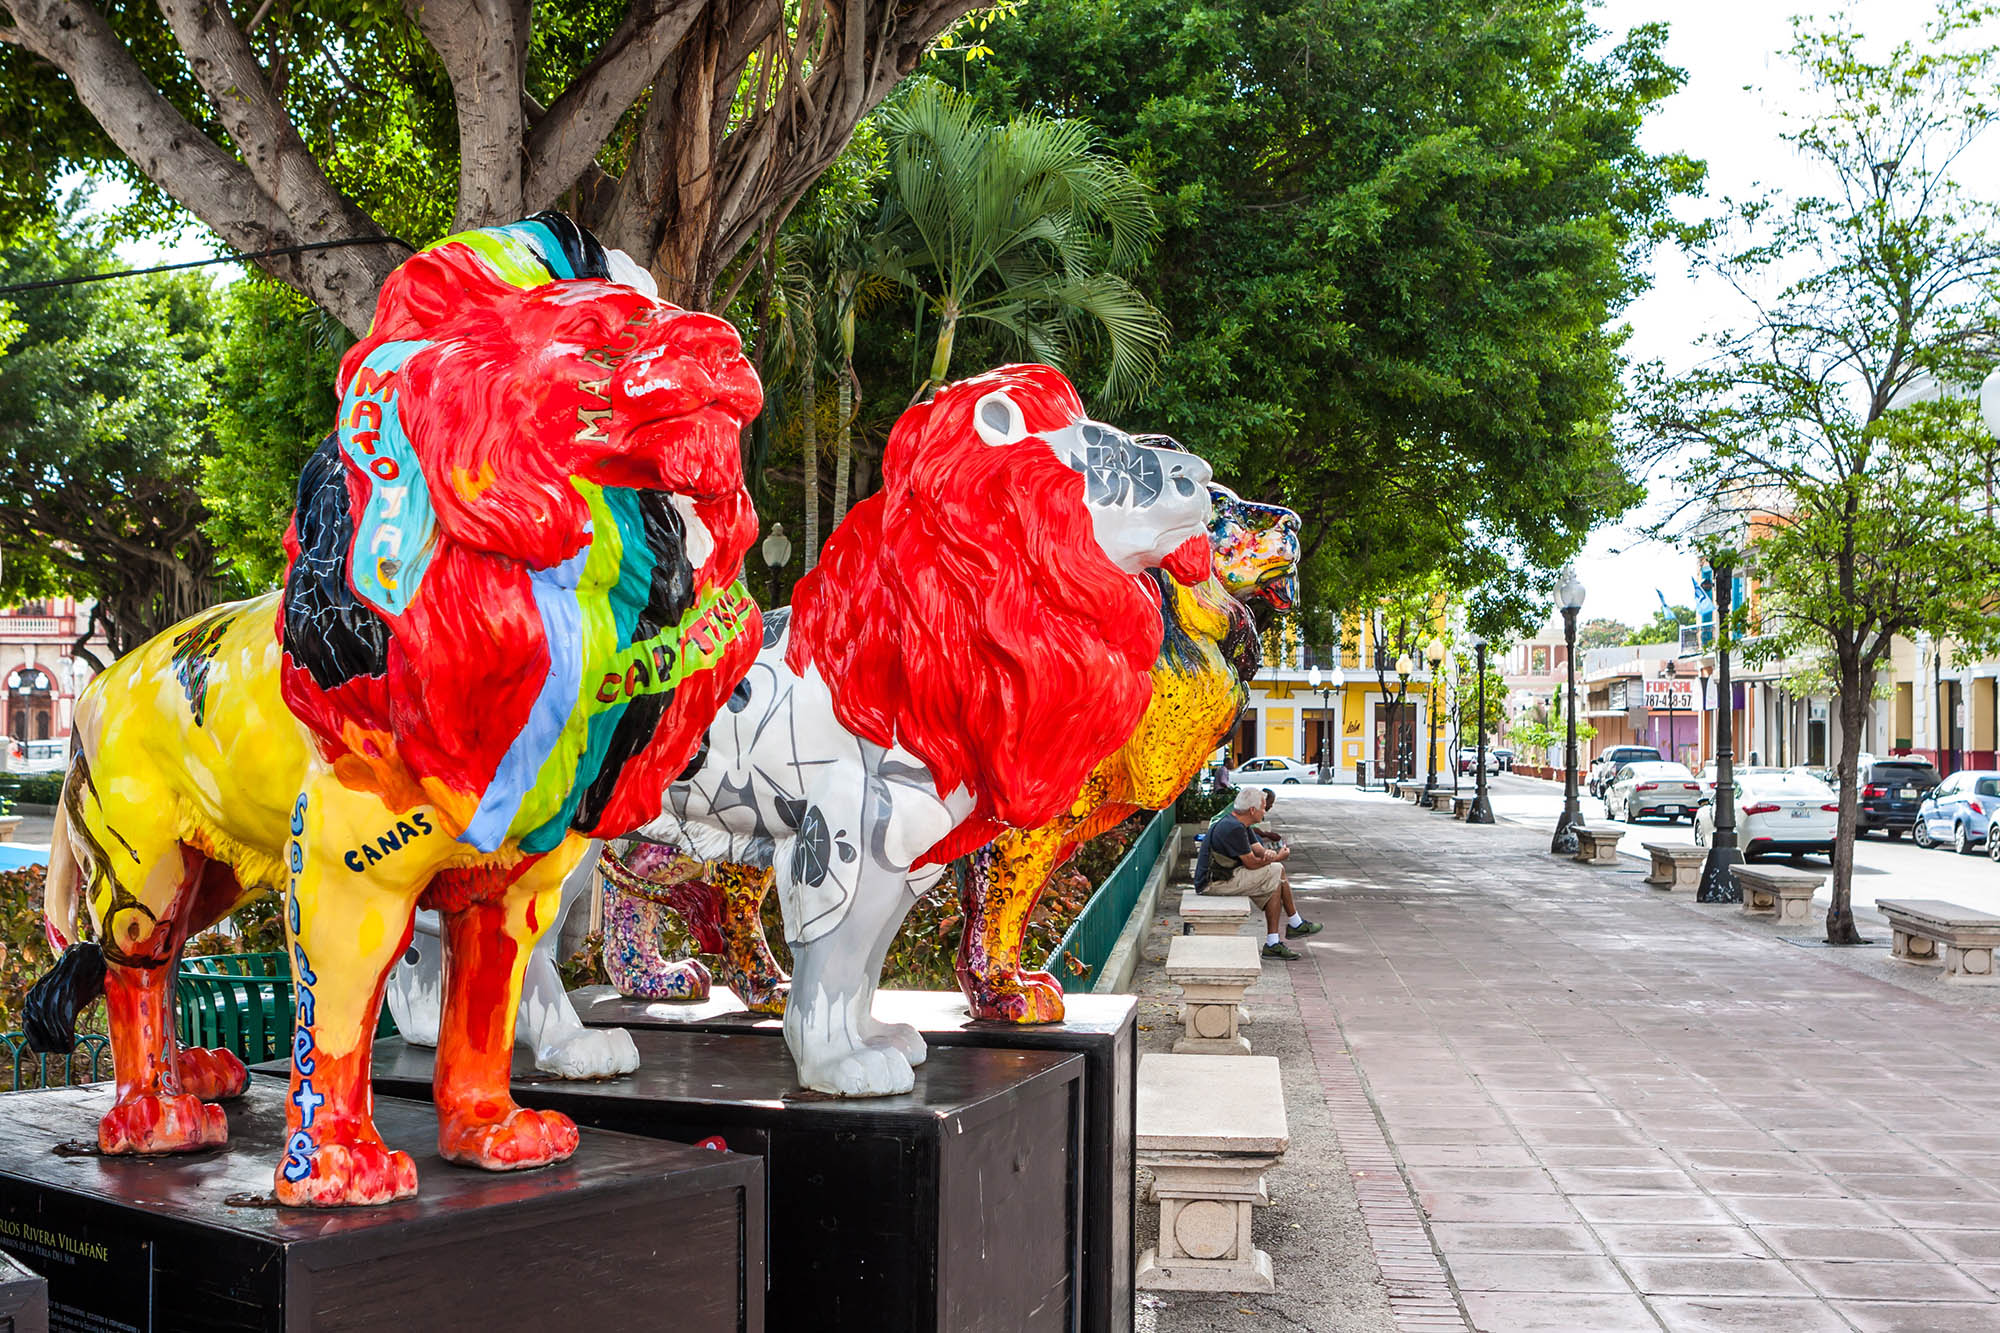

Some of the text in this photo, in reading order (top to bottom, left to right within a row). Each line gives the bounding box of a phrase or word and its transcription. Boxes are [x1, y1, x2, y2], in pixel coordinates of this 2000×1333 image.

[1646, 681, 1670, 693] FOR
[344, 813, 432, 872] CANAS
[23, 1223, 56, 1249] RIVERA
[58, 1233, 109, 1262] VILLAFAÑE
